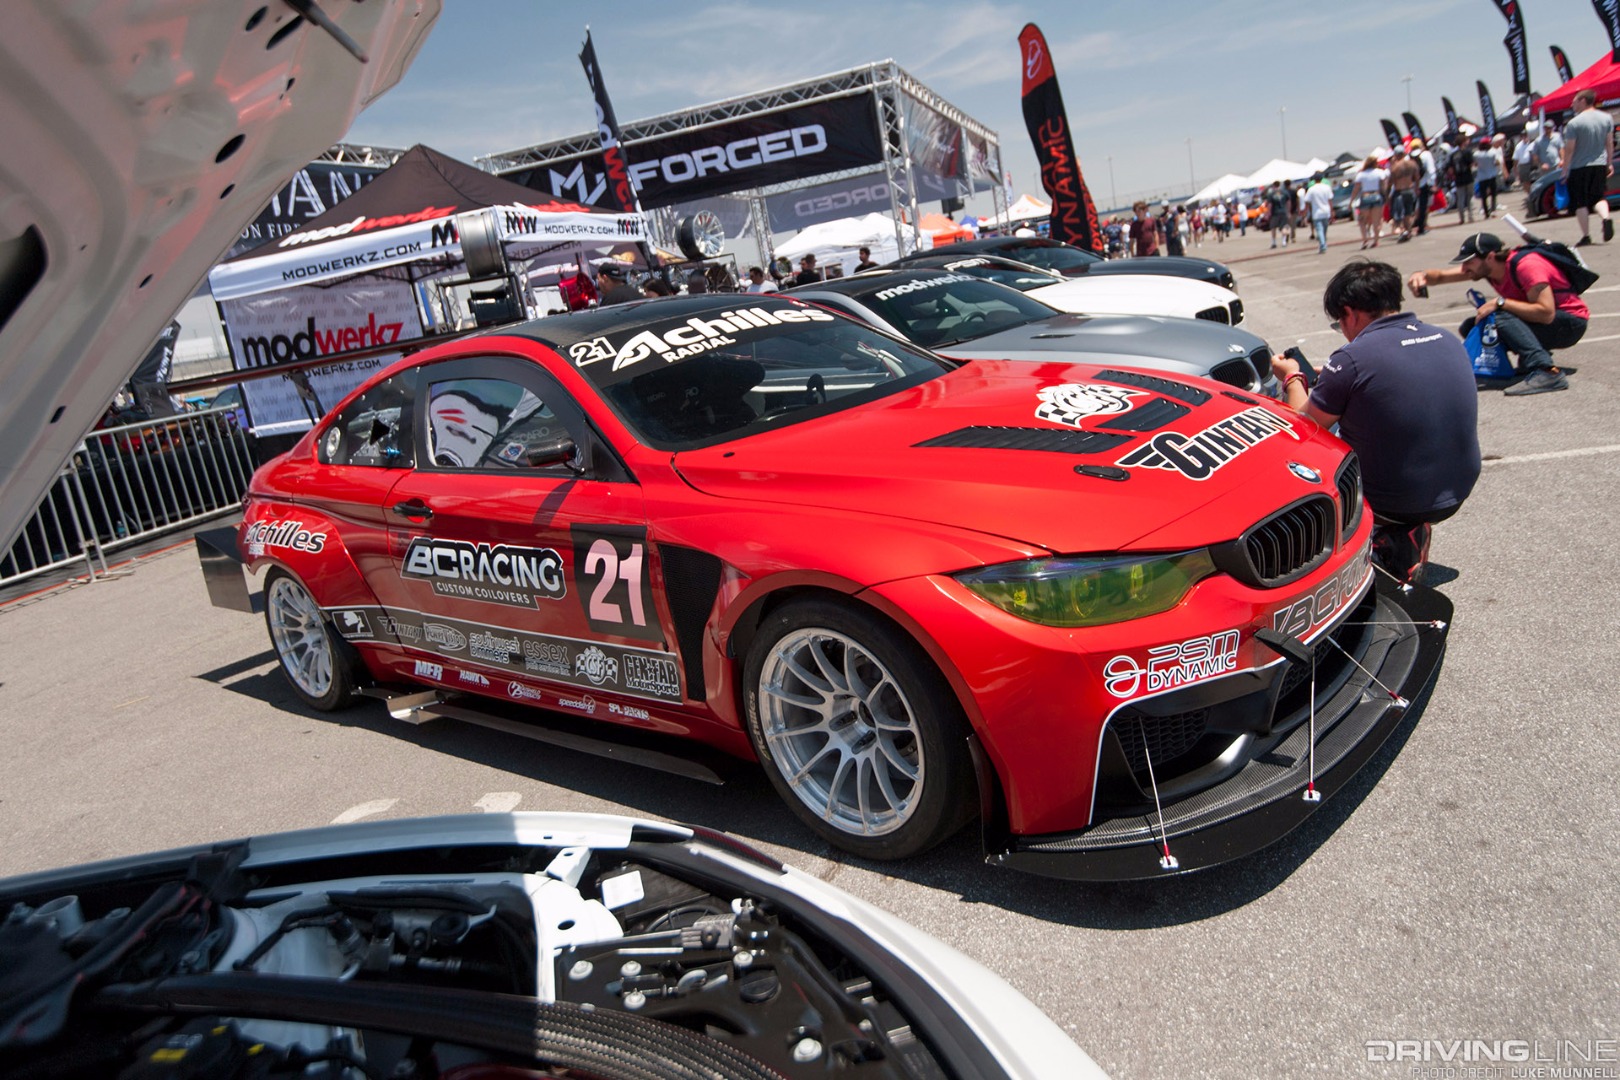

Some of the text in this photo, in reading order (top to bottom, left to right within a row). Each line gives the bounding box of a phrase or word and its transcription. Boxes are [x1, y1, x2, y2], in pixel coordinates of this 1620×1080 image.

[627, 124, 828, 192] FORGED
[1046, 115, 1083, 245] YNAMIC
[278, 206, 457, 248] modwerkz
[544, 224, 614, 235] MODWERKZ.COM
[282, 242, 422, 281] MODWERKZ.COM
[875, 273, 977, 301] modwerkz
[241, 313, 404, 366] modwerkz
[569, 337, 617, 367] 21
[612, 308, 834, 372] Achilles
[661, 336, 736, 363] RADIAL
[1148, 406, 1300, 481] GINTANI
[244, 520, 327, 554] Achilles
[436, 582, 530, 604] CUSTOM COILOVERS
[584, 539, 647, 627] 21
[523, 639, 571, 665] essex
[1148, 629, 1240, 670] PSM
[414, 660, 443, 680] MFR
[460, 670, 481, 683] HAWK
[1148, 653, 1238, 691] DYNAMIC
[608, 702, 623, 714] SPL
